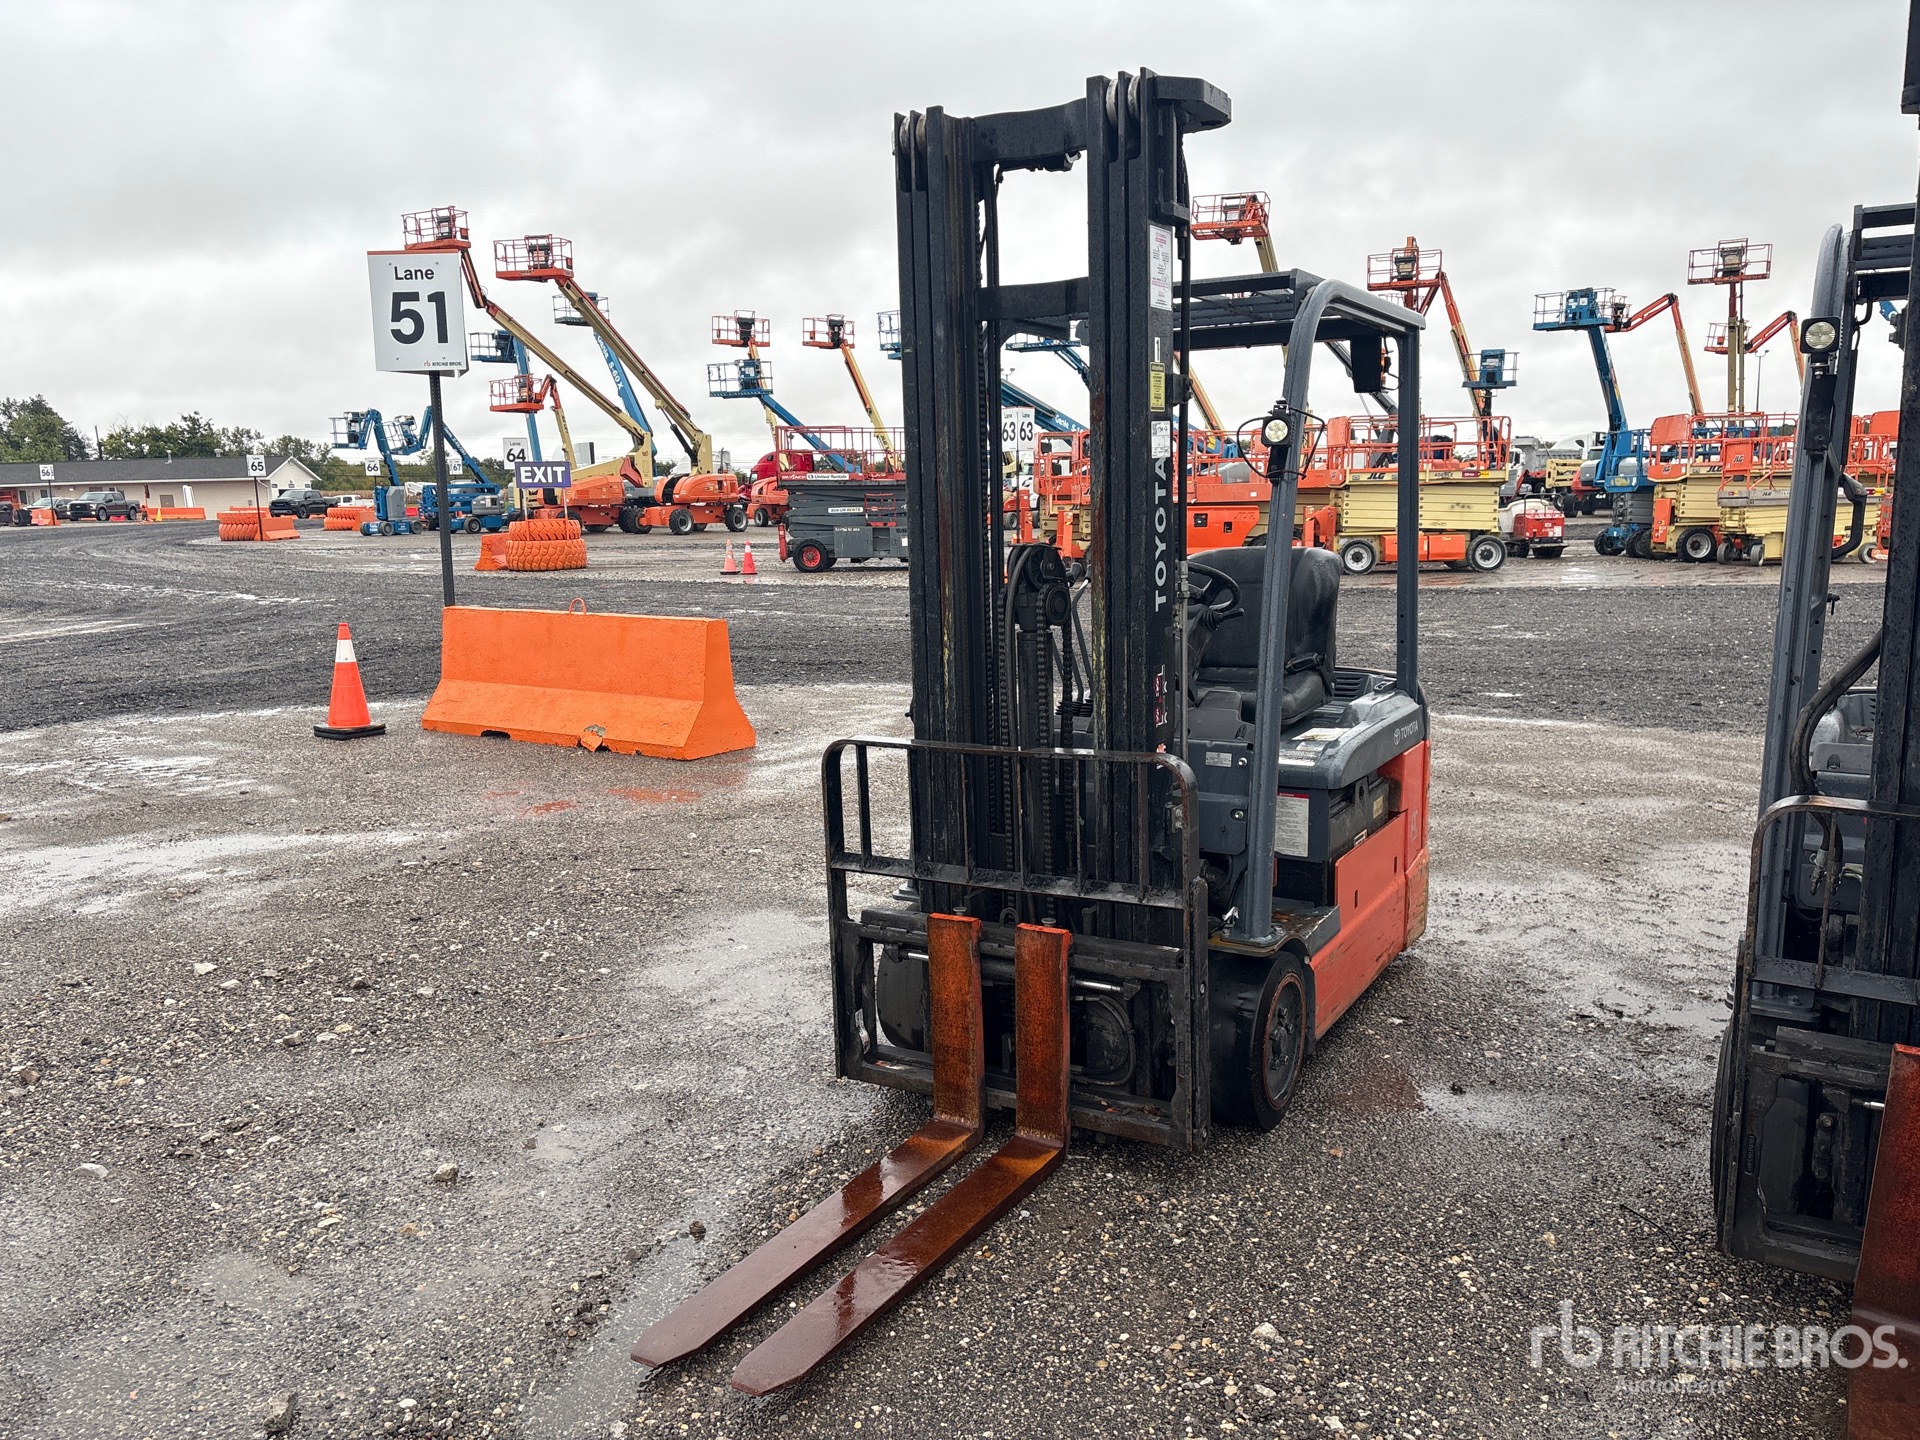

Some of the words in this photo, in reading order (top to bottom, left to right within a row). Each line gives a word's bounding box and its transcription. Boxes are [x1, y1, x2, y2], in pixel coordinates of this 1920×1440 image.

[394, 266, 434, 280] Lane
[390, 291, 448, 344] 51
[1002, 422, 1016, 442] 63
[1019, 422, 1033, 442] 63
[506, 448, 526, 462] 64
[251, 462, 264, 471] 65
[367, 463, 379, 471] 66
[520, 466, 566, 483] EXIT
[1367, 472, 1386, 480] JLG
[1154, 457, 1167, 612] TOYOTA
[1400, 720, 1419, 740] TOYOTA
